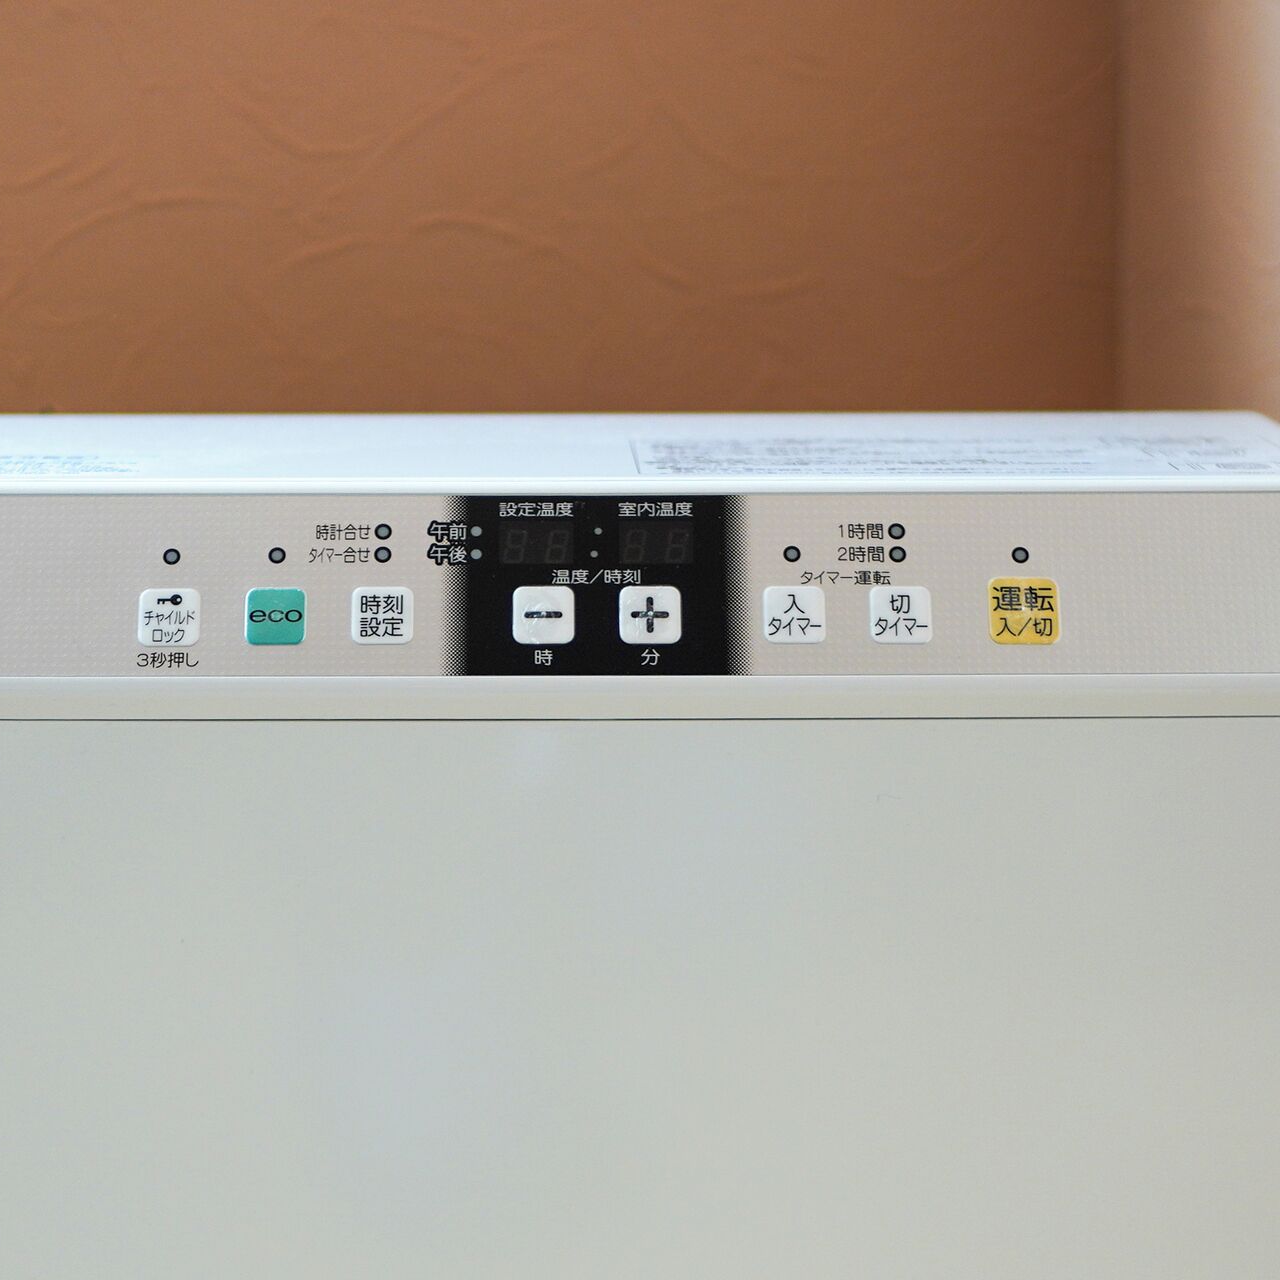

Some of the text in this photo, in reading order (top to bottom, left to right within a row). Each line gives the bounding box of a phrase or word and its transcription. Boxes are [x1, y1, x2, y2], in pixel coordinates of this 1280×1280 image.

[499, 502, 574, 517] 設定温度
[618, 502, 694, 517] 室内温度
[315, 523, 371, 541] 時計合せ
[429, 521, 468, 541] 午前
[837, 523, 884, 540] 1時間
[308, 546, 371, 564] タイマー合せ
[429, 544, 468, 564] 午後
[837, 546, 885, 563] 2時間
[800, 570, 891, 586] タイマー運転
[360, 594, 404, 615] 時刻
[783, 593, 806, 614] 入
[889, 594, 911, 615] 切
[991, 586, 1055, 613] 運転
[143, 610, 195, 626] チャイルド
[248, 609, 304, 624] eco
[360, 617, 404, 638] 設定
[768, 616, 822, 636] タイマー
[874, 617, 929, 637] タイマー
[152, 628, 185, 644] ロック
[136, 652, 199, 669] 3秒押し
[534, 648, 553, 666] 時
[640, 648, 661, 666] 分
